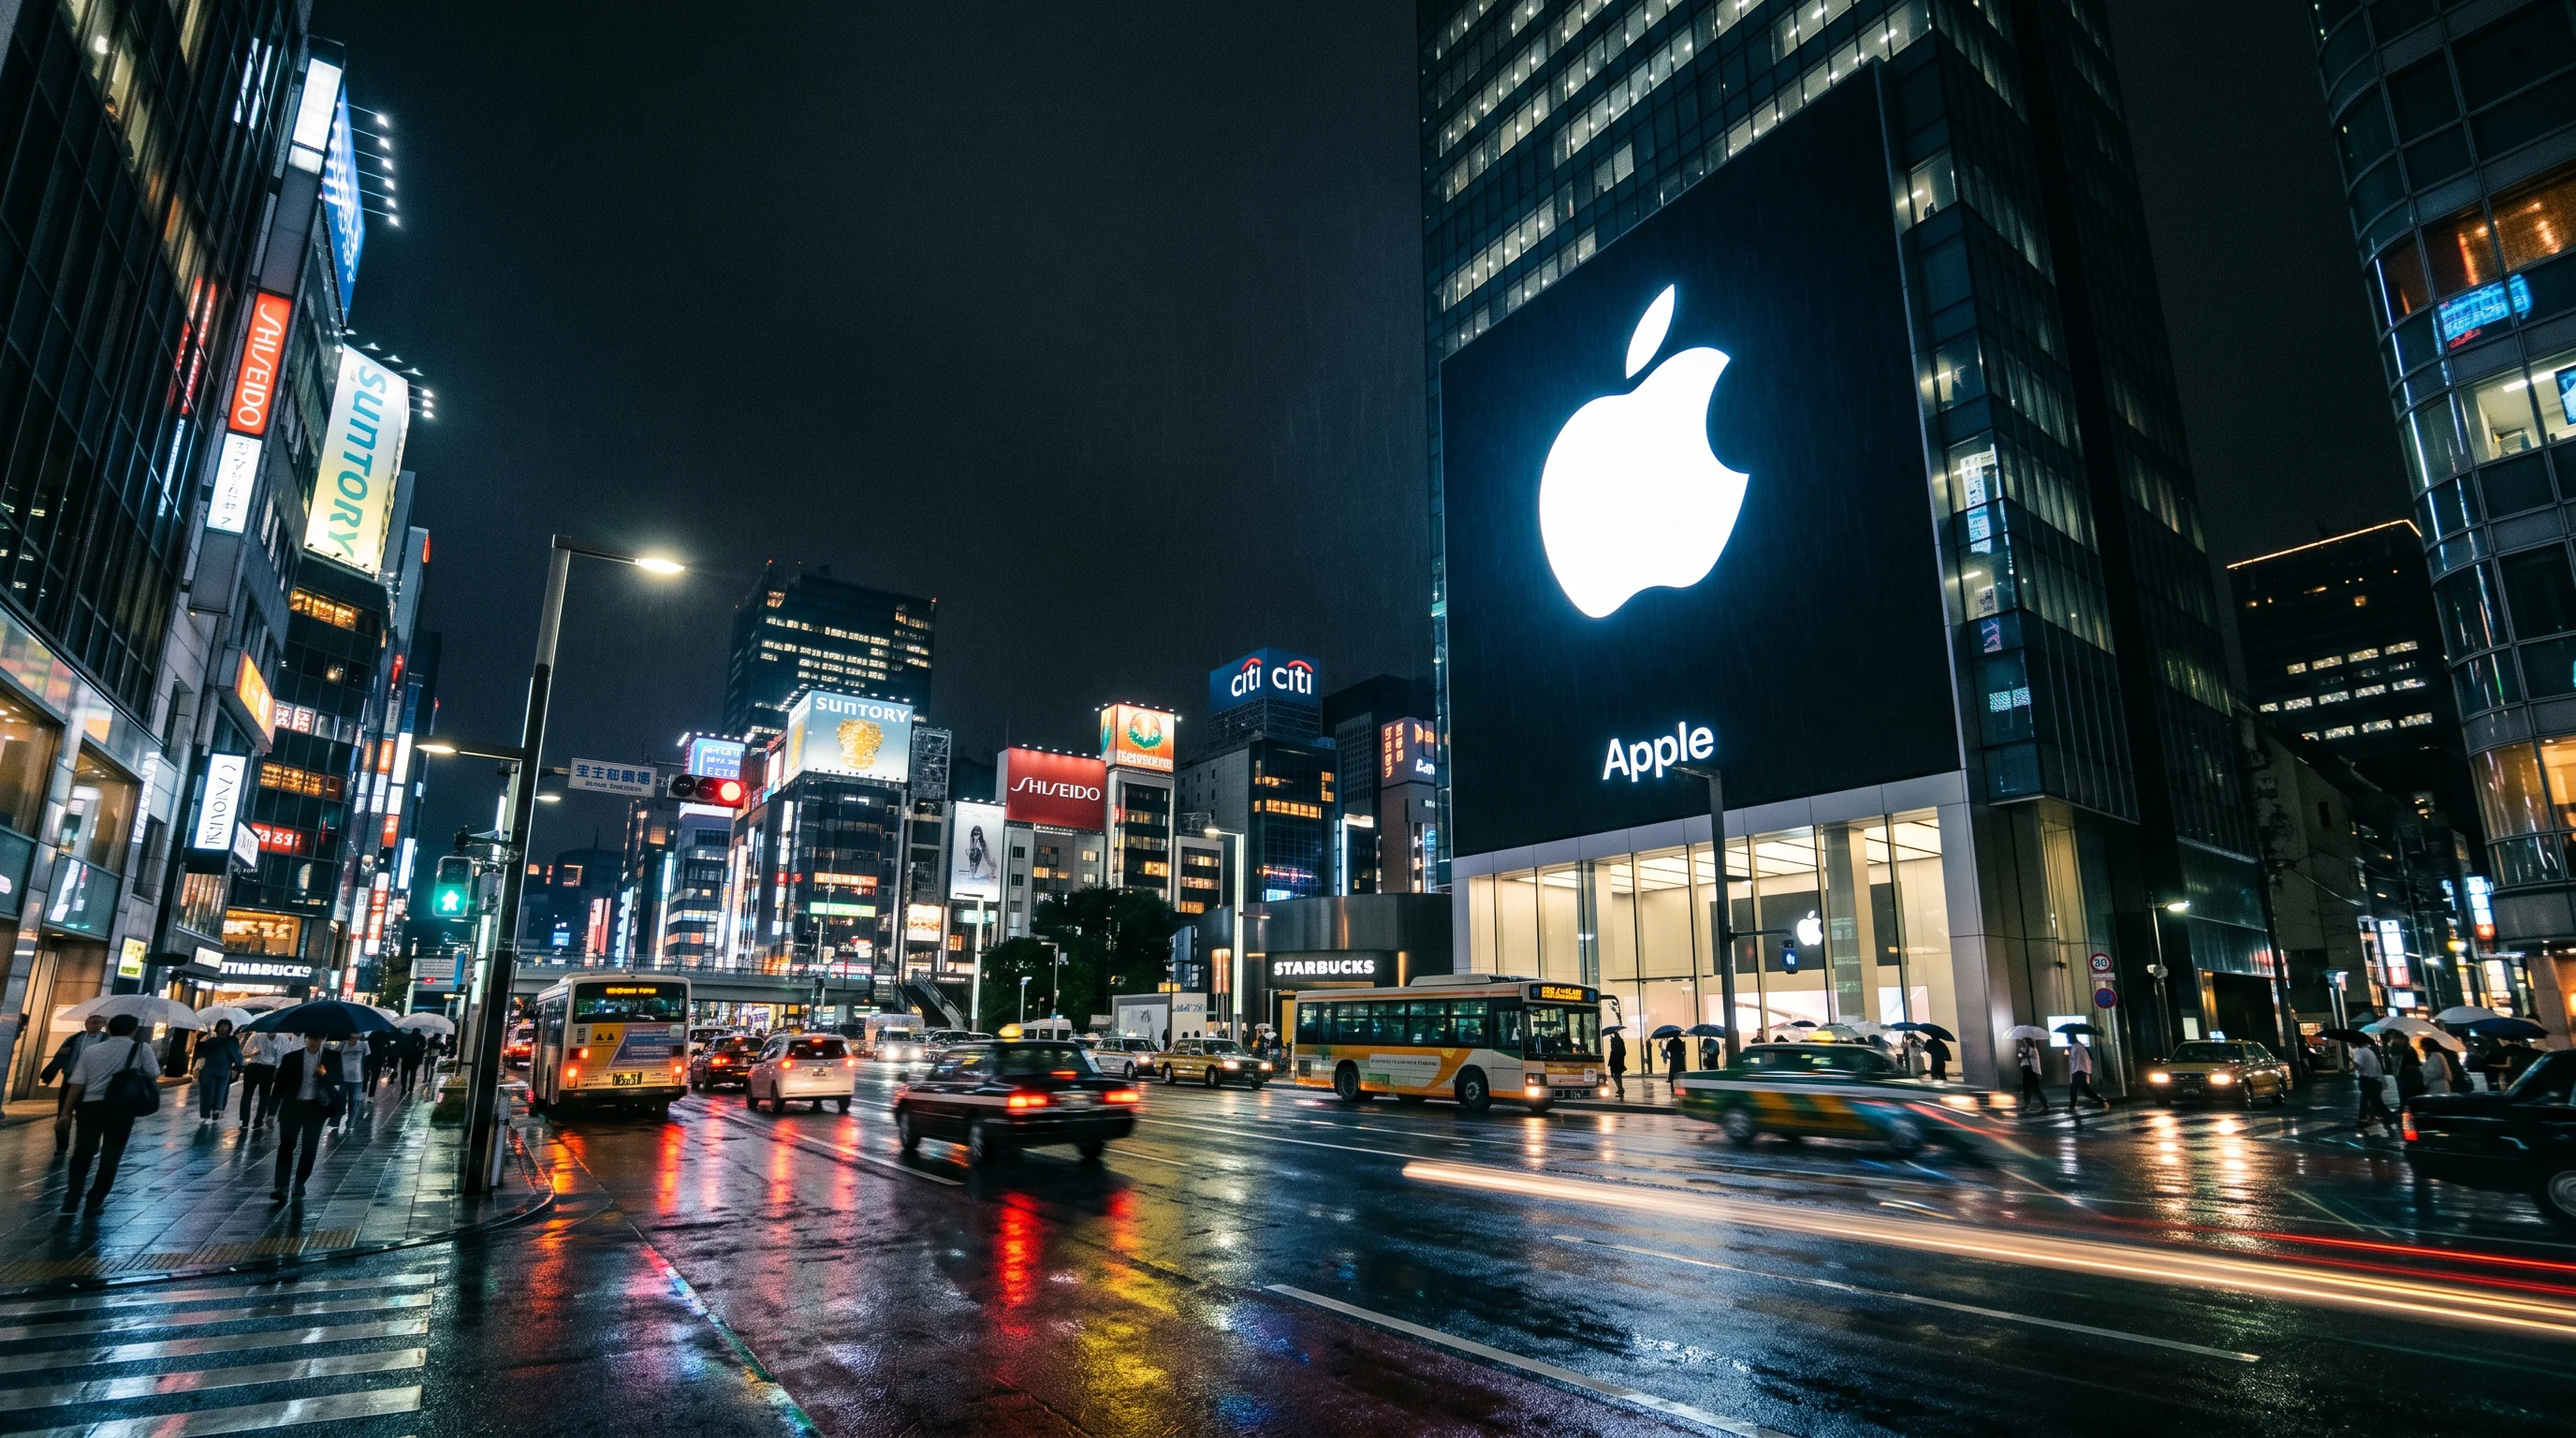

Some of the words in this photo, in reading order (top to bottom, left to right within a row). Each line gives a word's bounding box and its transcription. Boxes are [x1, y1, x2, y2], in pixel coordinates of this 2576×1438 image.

[237, 303, 282, 427] SHISEIDO
[328, 365, 388, 558] SUNTORY
[1231, 664, 1261, 697] citi
[1272, 666, 1312, 696] citi
[815, 697, 910, 723] SUNTORY
[1603, 721, 1714, 783] Apple
[1010, 776, 1101, 801] SHISEIDO
[1273, 959, 1375, 976] STARBUCKS
